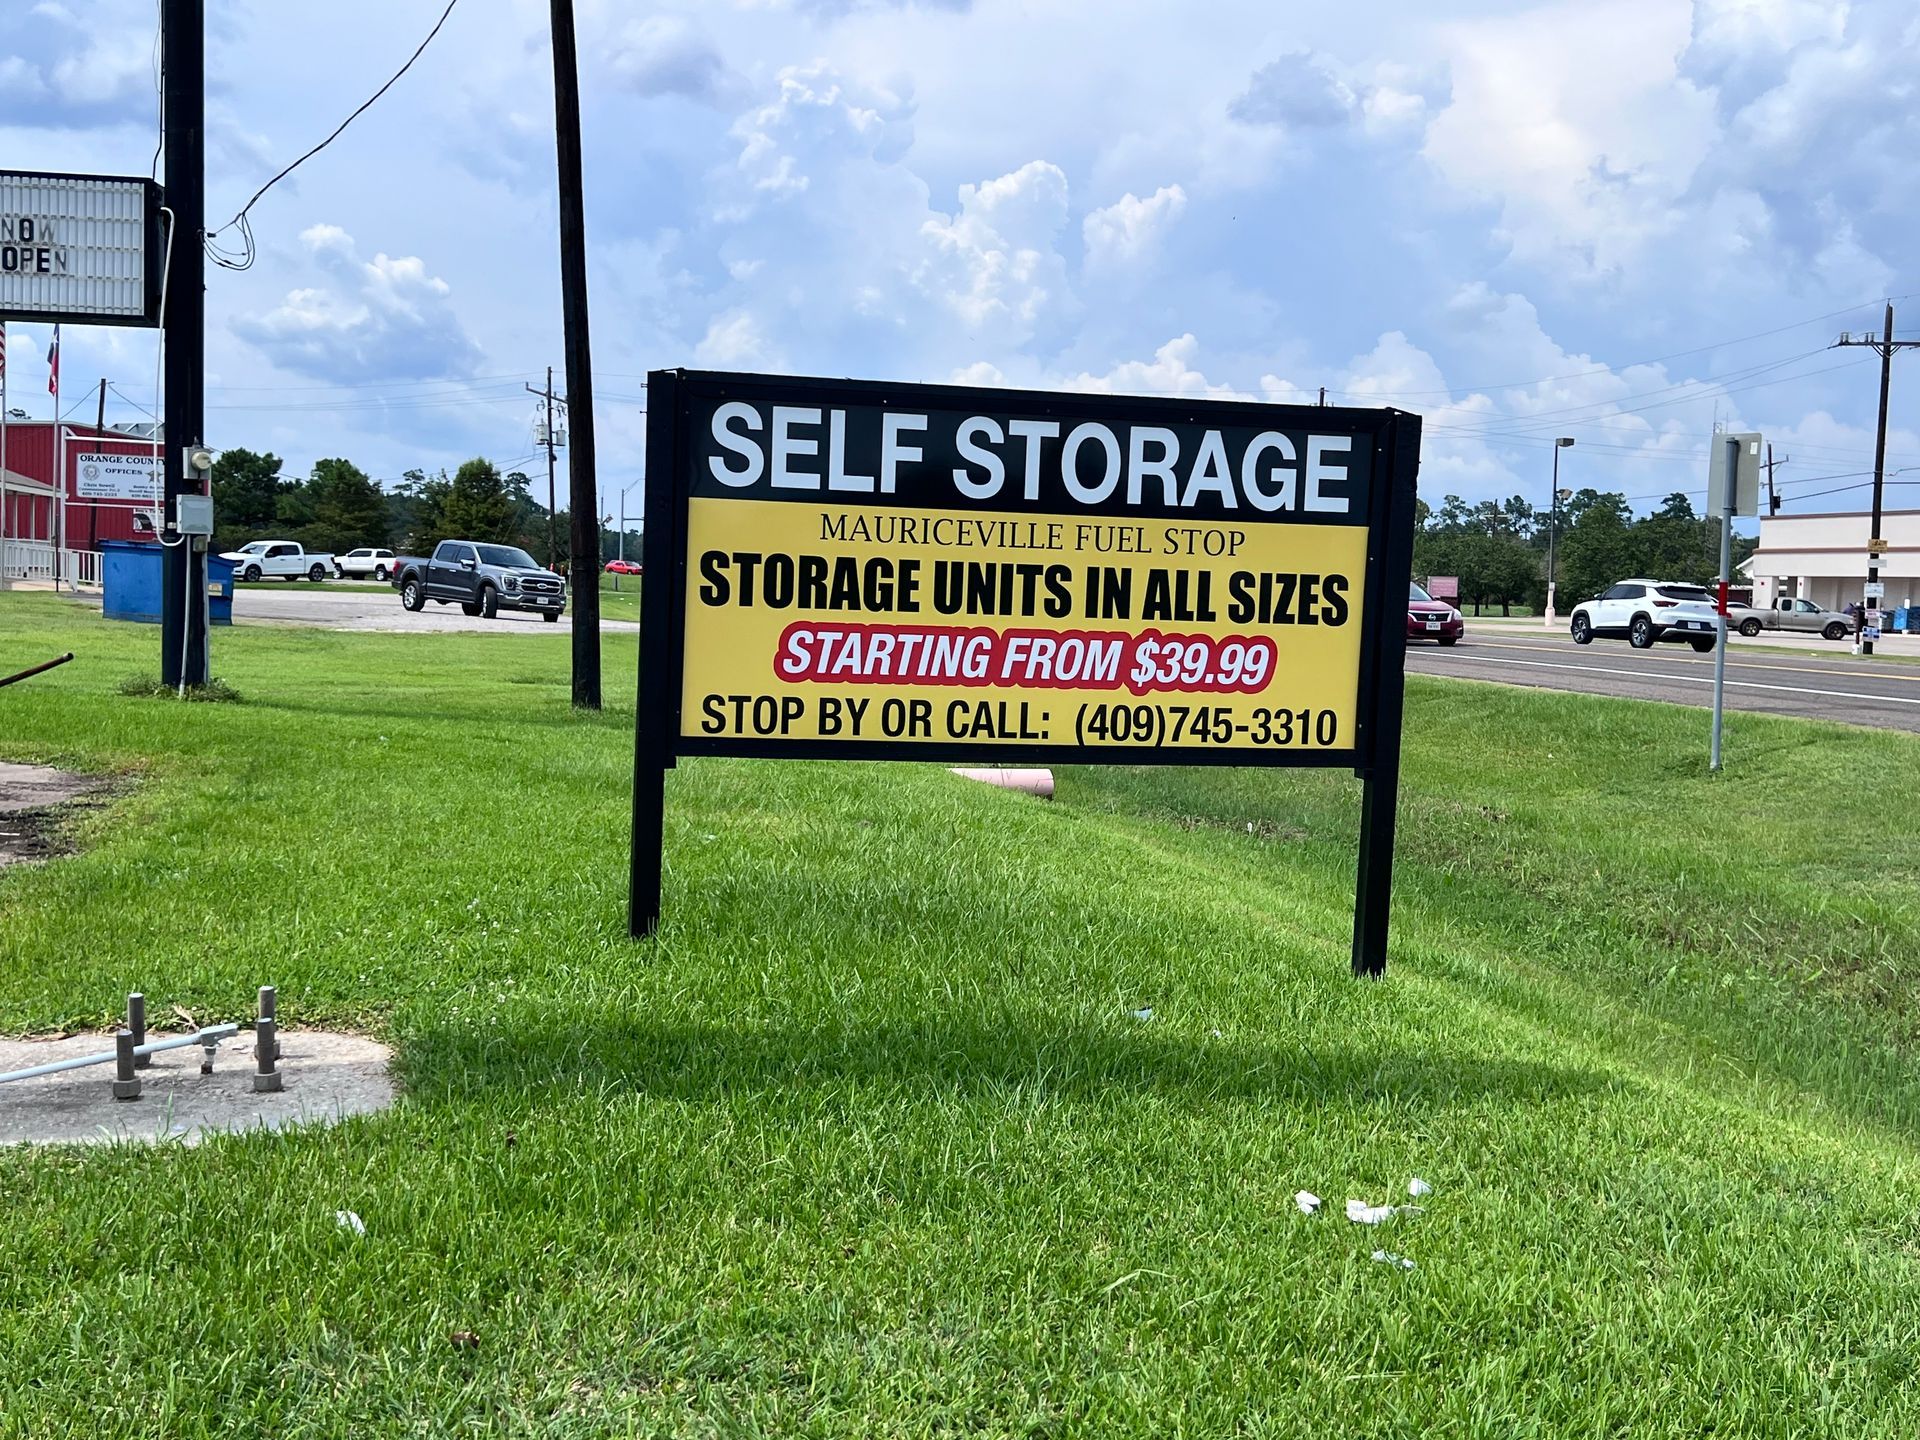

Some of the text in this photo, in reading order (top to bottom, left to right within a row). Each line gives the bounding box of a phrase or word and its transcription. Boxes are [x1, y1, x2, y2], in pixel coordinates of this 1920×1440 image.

[2, 218, 57, 242] NOW
[2, 246, 67, 272] OPEN
[80, 454, 123, 464] ORANGE
[105, 467, 143, 475] OFFICES
[709, 402, 1351, 511] SELF STORAGE
[820, 514, 1246, 556] MAURICEVILLE FUEL STOP
[700, 551, 1348, 626] STORAGE UNITS IN ALL SIZES
[783, 630, 1270, 687] STARTING FROM $39.99
[702, 694, 1337, 748] STOP BY OR CALL: (409)745-3310
